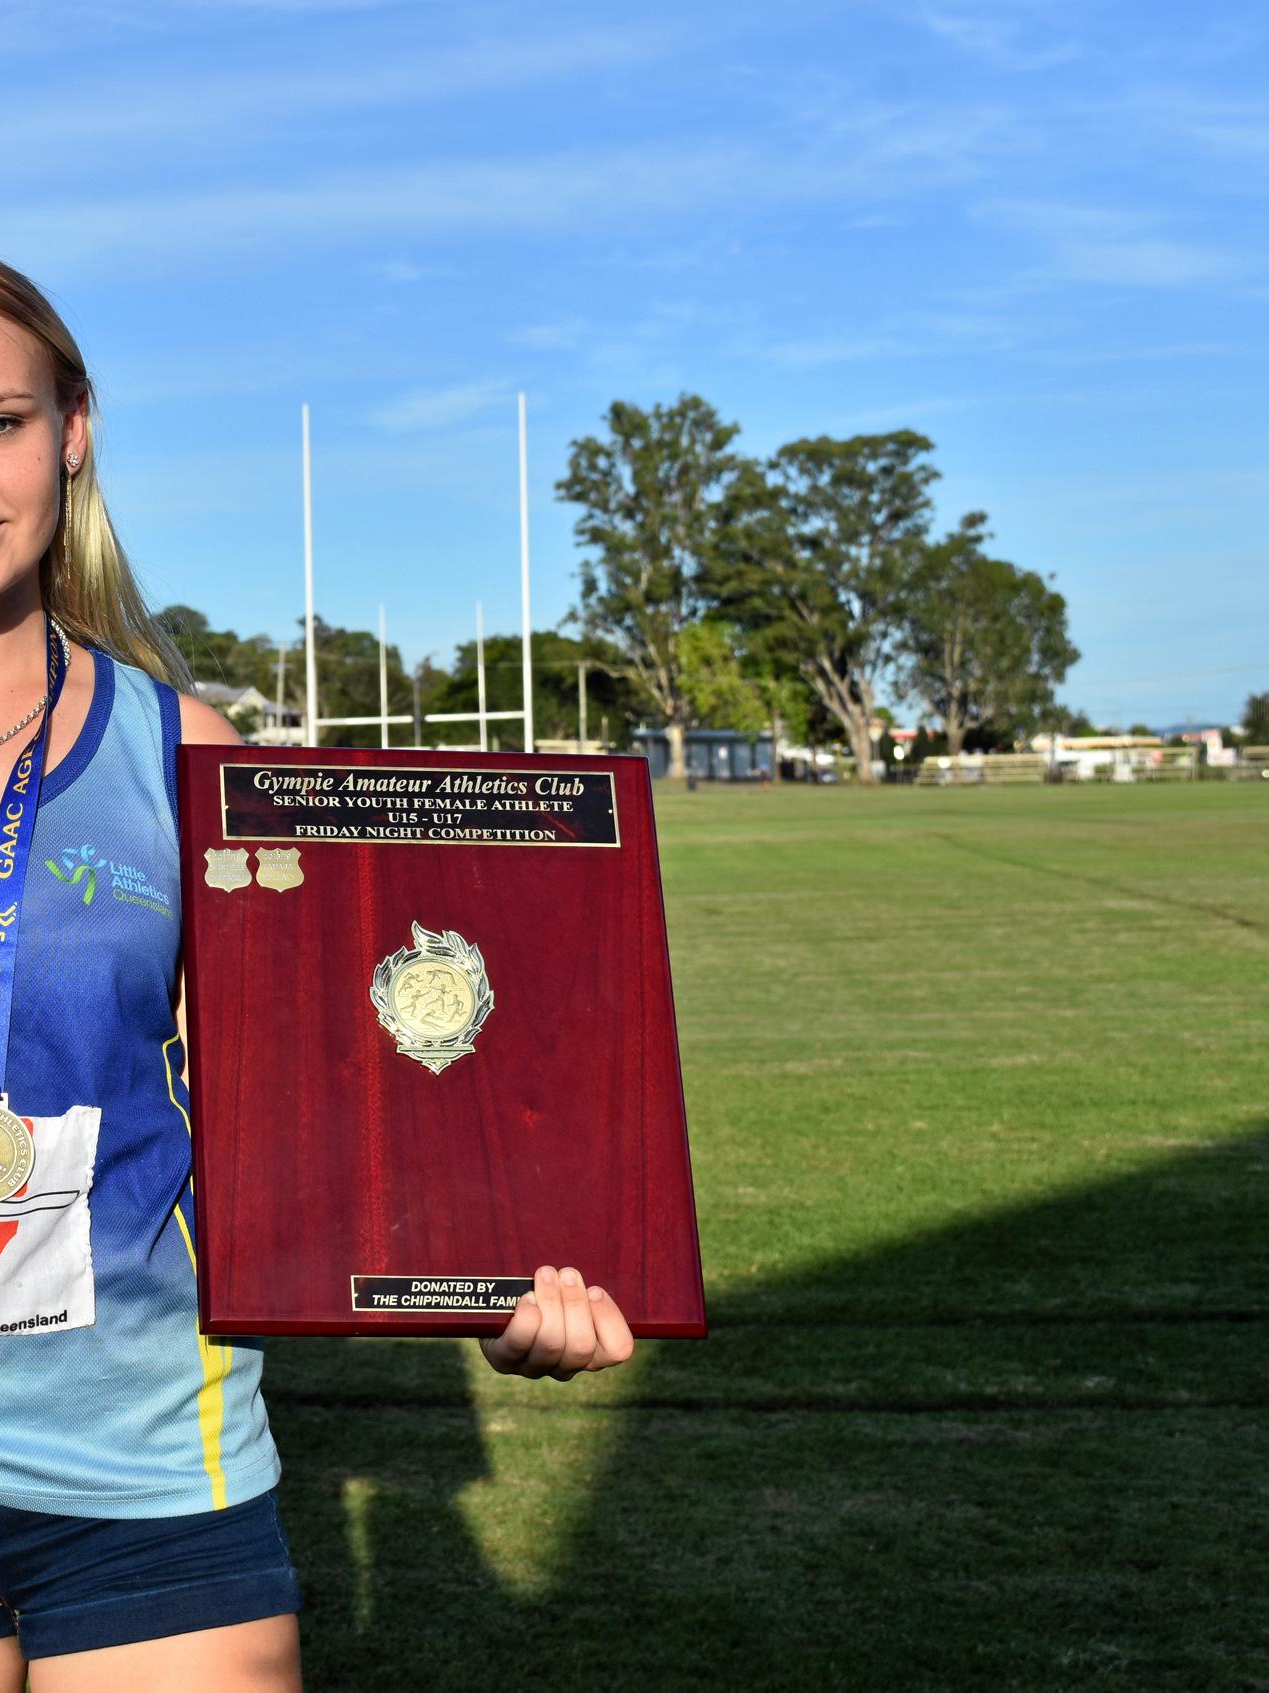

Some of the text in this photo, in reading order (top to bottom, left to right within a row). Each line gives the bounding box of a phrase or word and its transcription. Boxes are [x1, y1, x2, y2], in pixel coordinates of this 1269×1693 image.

[253, 770, 584, 796] Gympie Amateur Athletics Club
[273, 795, 574, 812] SENIOR YOUTH FEMALE ATHLETE
[387, 812, 418, 824] U15
[432, 813, 462, 825] U17
[294, 825, 556, 841] FRIDAY NIGHT COMPETITION
[110, 861, 146, 881] Little
[112, 876, 170, 905] Athletics
[7, 1159, 27, 1187] CLUB
[411, 1281, 496, 1293] DONATED BY
[372, 1294, 398, 1306] THE
[400, 1294, 487, 1307] CHIPPINDALL
